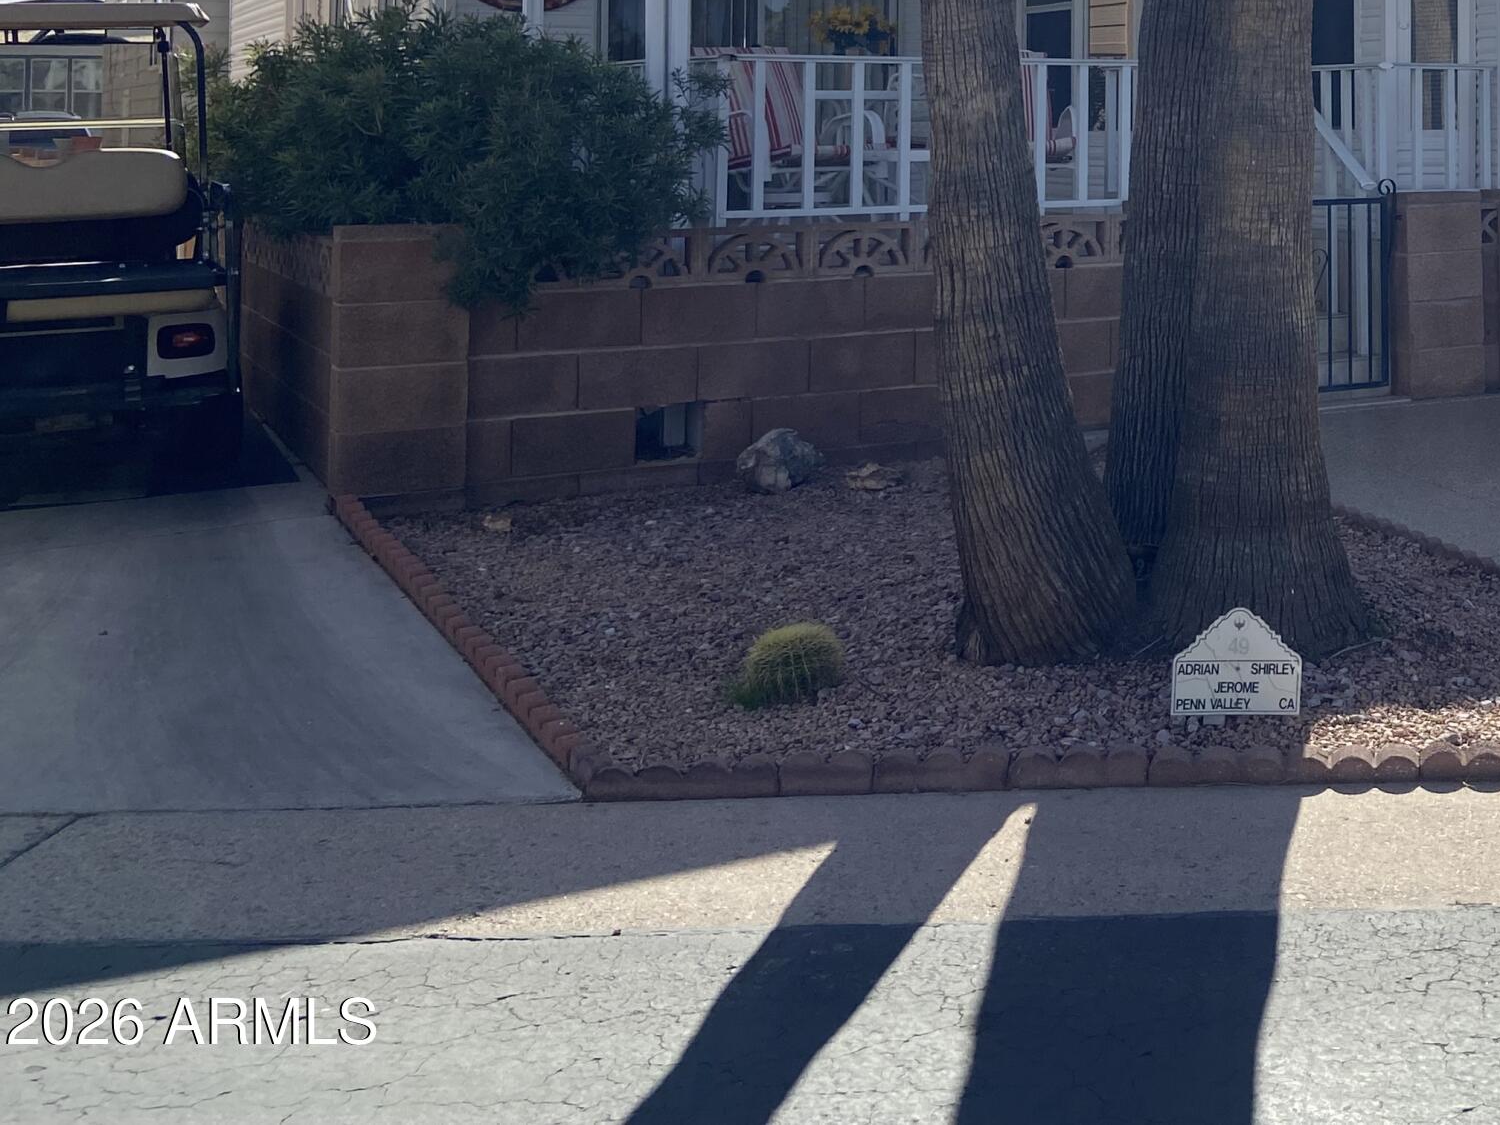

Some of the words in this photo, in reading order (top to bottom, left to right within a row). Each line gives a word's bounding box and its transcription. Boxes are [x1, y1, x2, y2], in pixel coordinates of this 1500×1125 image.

[1177, 663, 1220, 675] ADRIAN
[1251, 663, 1295, 675] SHIRLEY
[1214, 681, 1259, 693] JEROME
[1176, 698, 1206, 710] PENN
[1210, 698, 1251, 710] VALLEY
[1279, 697, 1295, 710] CA
